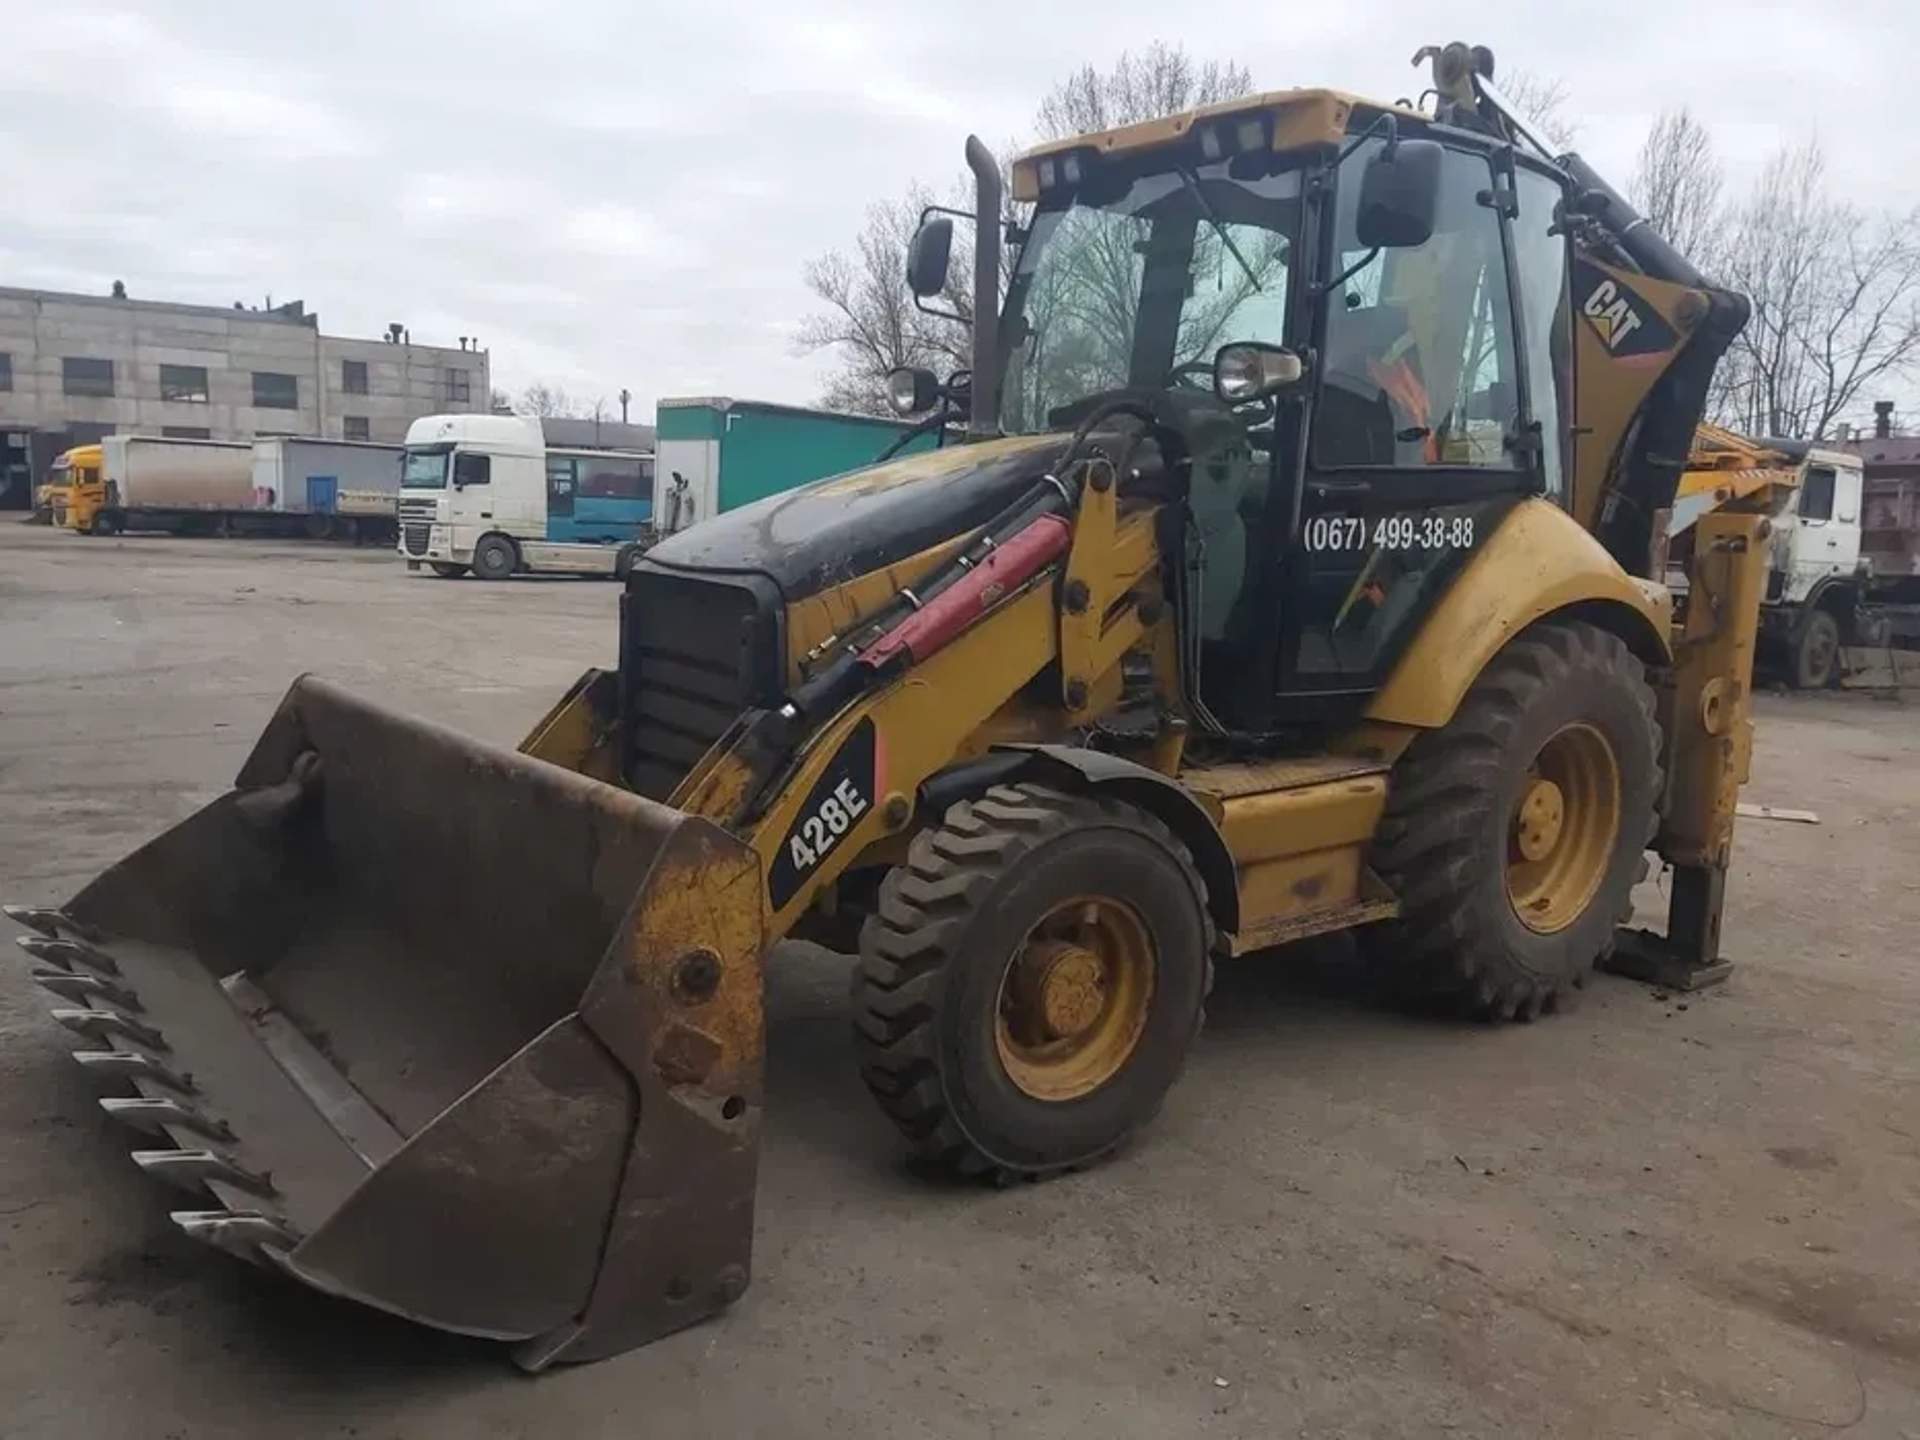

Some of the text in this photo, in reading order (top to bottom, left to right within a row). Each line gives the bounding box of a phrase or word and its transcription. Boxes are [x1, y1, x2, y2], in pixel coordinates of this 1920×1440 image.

[1584, 280, 1641, 349] CAT
[1304, 517, 1474, 552] (067) 499-38-88
[790, 778, 867, 870] 428E
